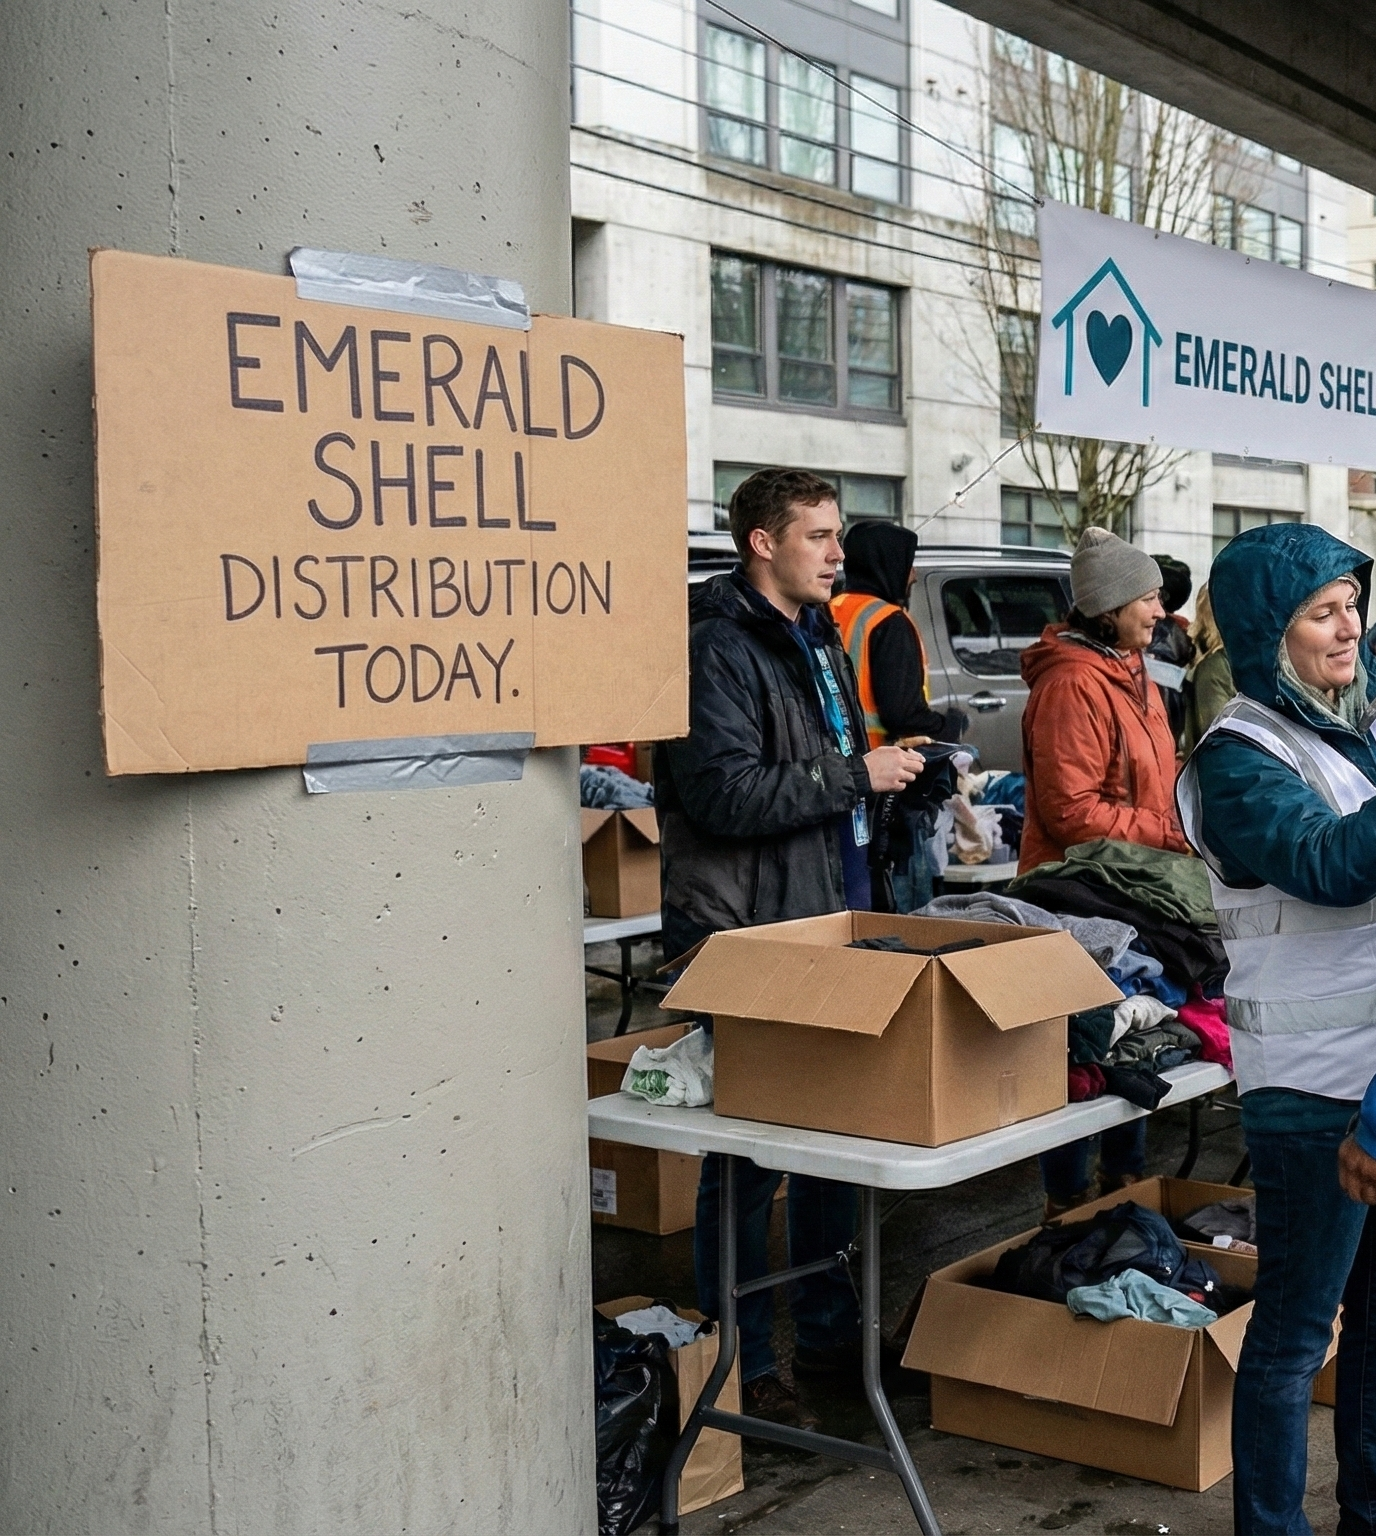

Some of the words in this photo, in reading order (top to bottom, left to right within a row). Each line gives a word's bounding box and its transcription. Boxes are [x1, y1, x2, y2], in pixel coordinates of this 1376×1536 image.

[226, 311, 606, 440] EMERALD
[1174, 331, 1312, 404] EMERALD
[307, 431, 557, 532] SHELL
[219, 553, 611, 622] DISTRIBUTION
[314, 638, 520, 709] TODAY.
